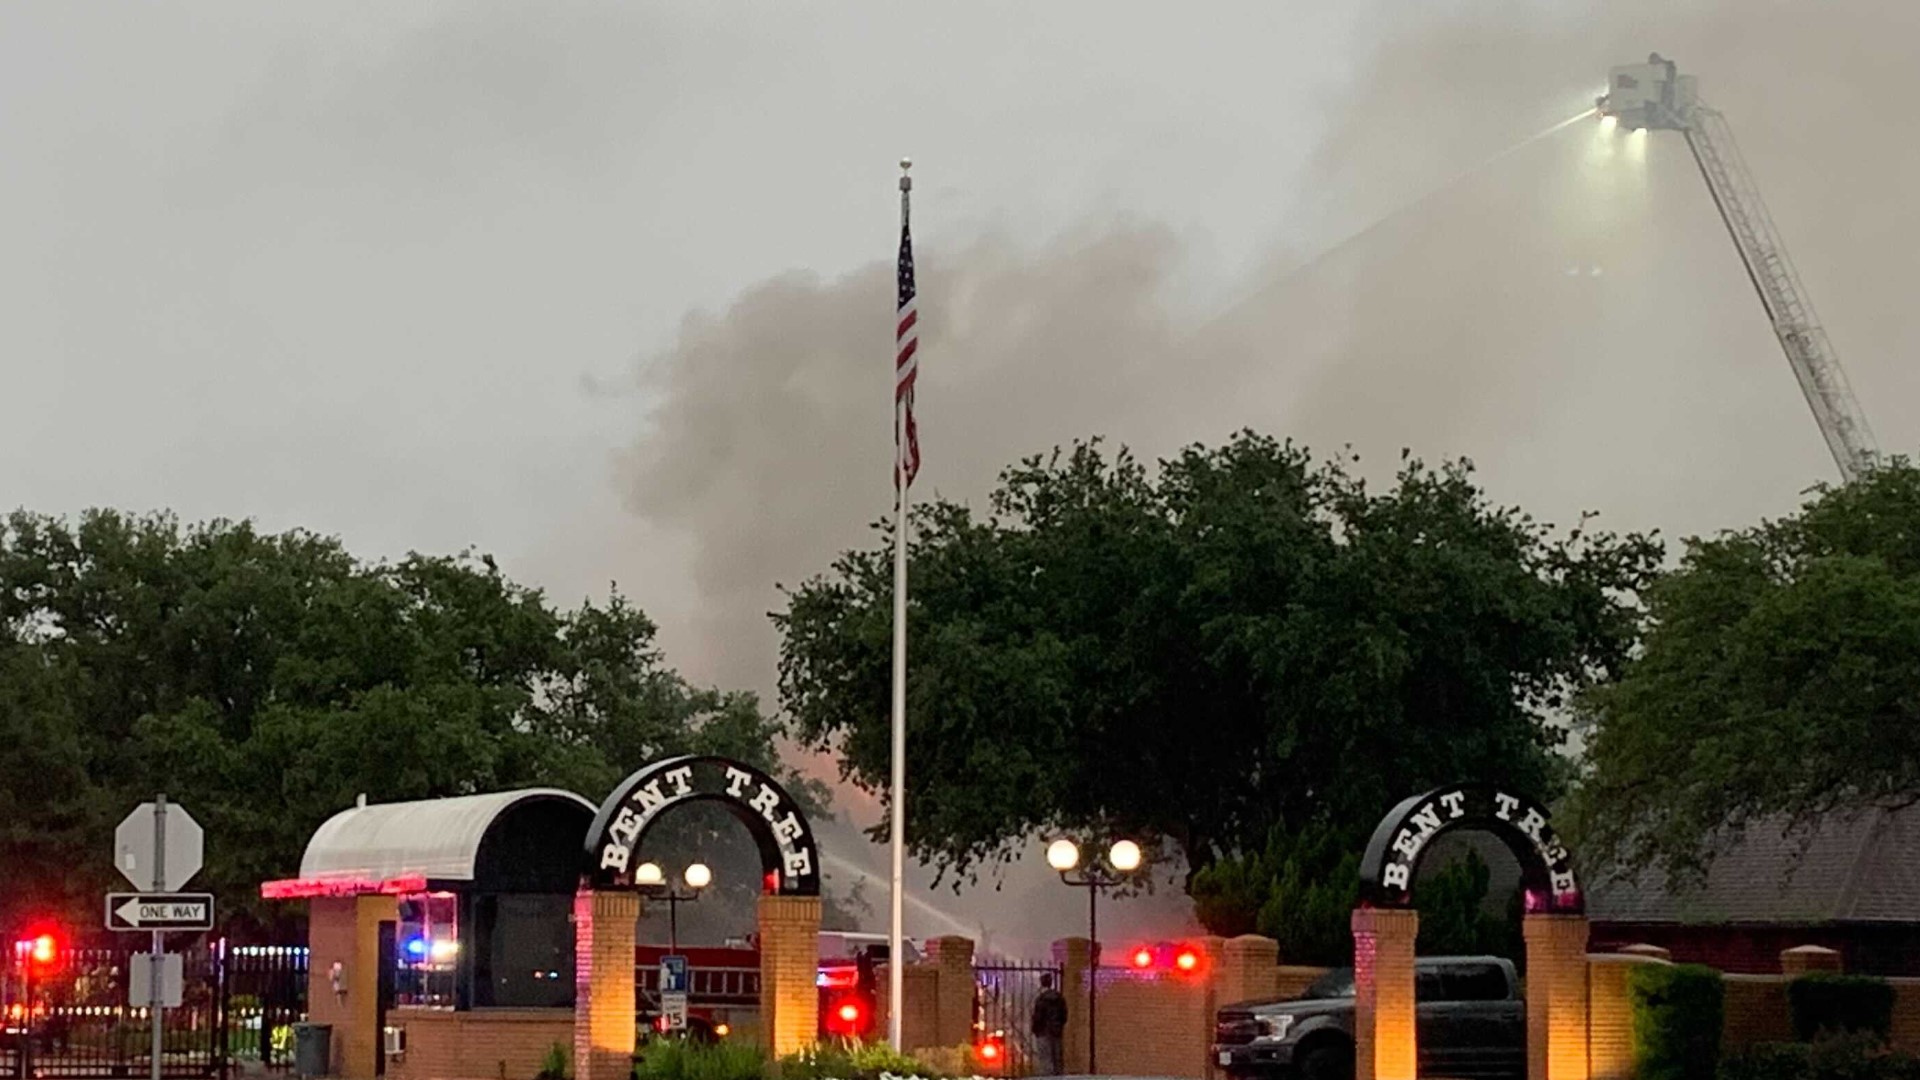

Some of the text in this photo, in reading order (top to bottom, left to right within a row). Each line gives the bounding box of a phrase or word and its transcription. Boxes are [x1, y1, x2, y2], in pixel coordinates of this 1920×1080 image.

[601, 765, 811, 877] BENT TREE
[1383, 790, 1576, 896] BENT TREE
[140, 905, 201, 918] ONE WAY
[667, 1012, 683, 1026] 15
